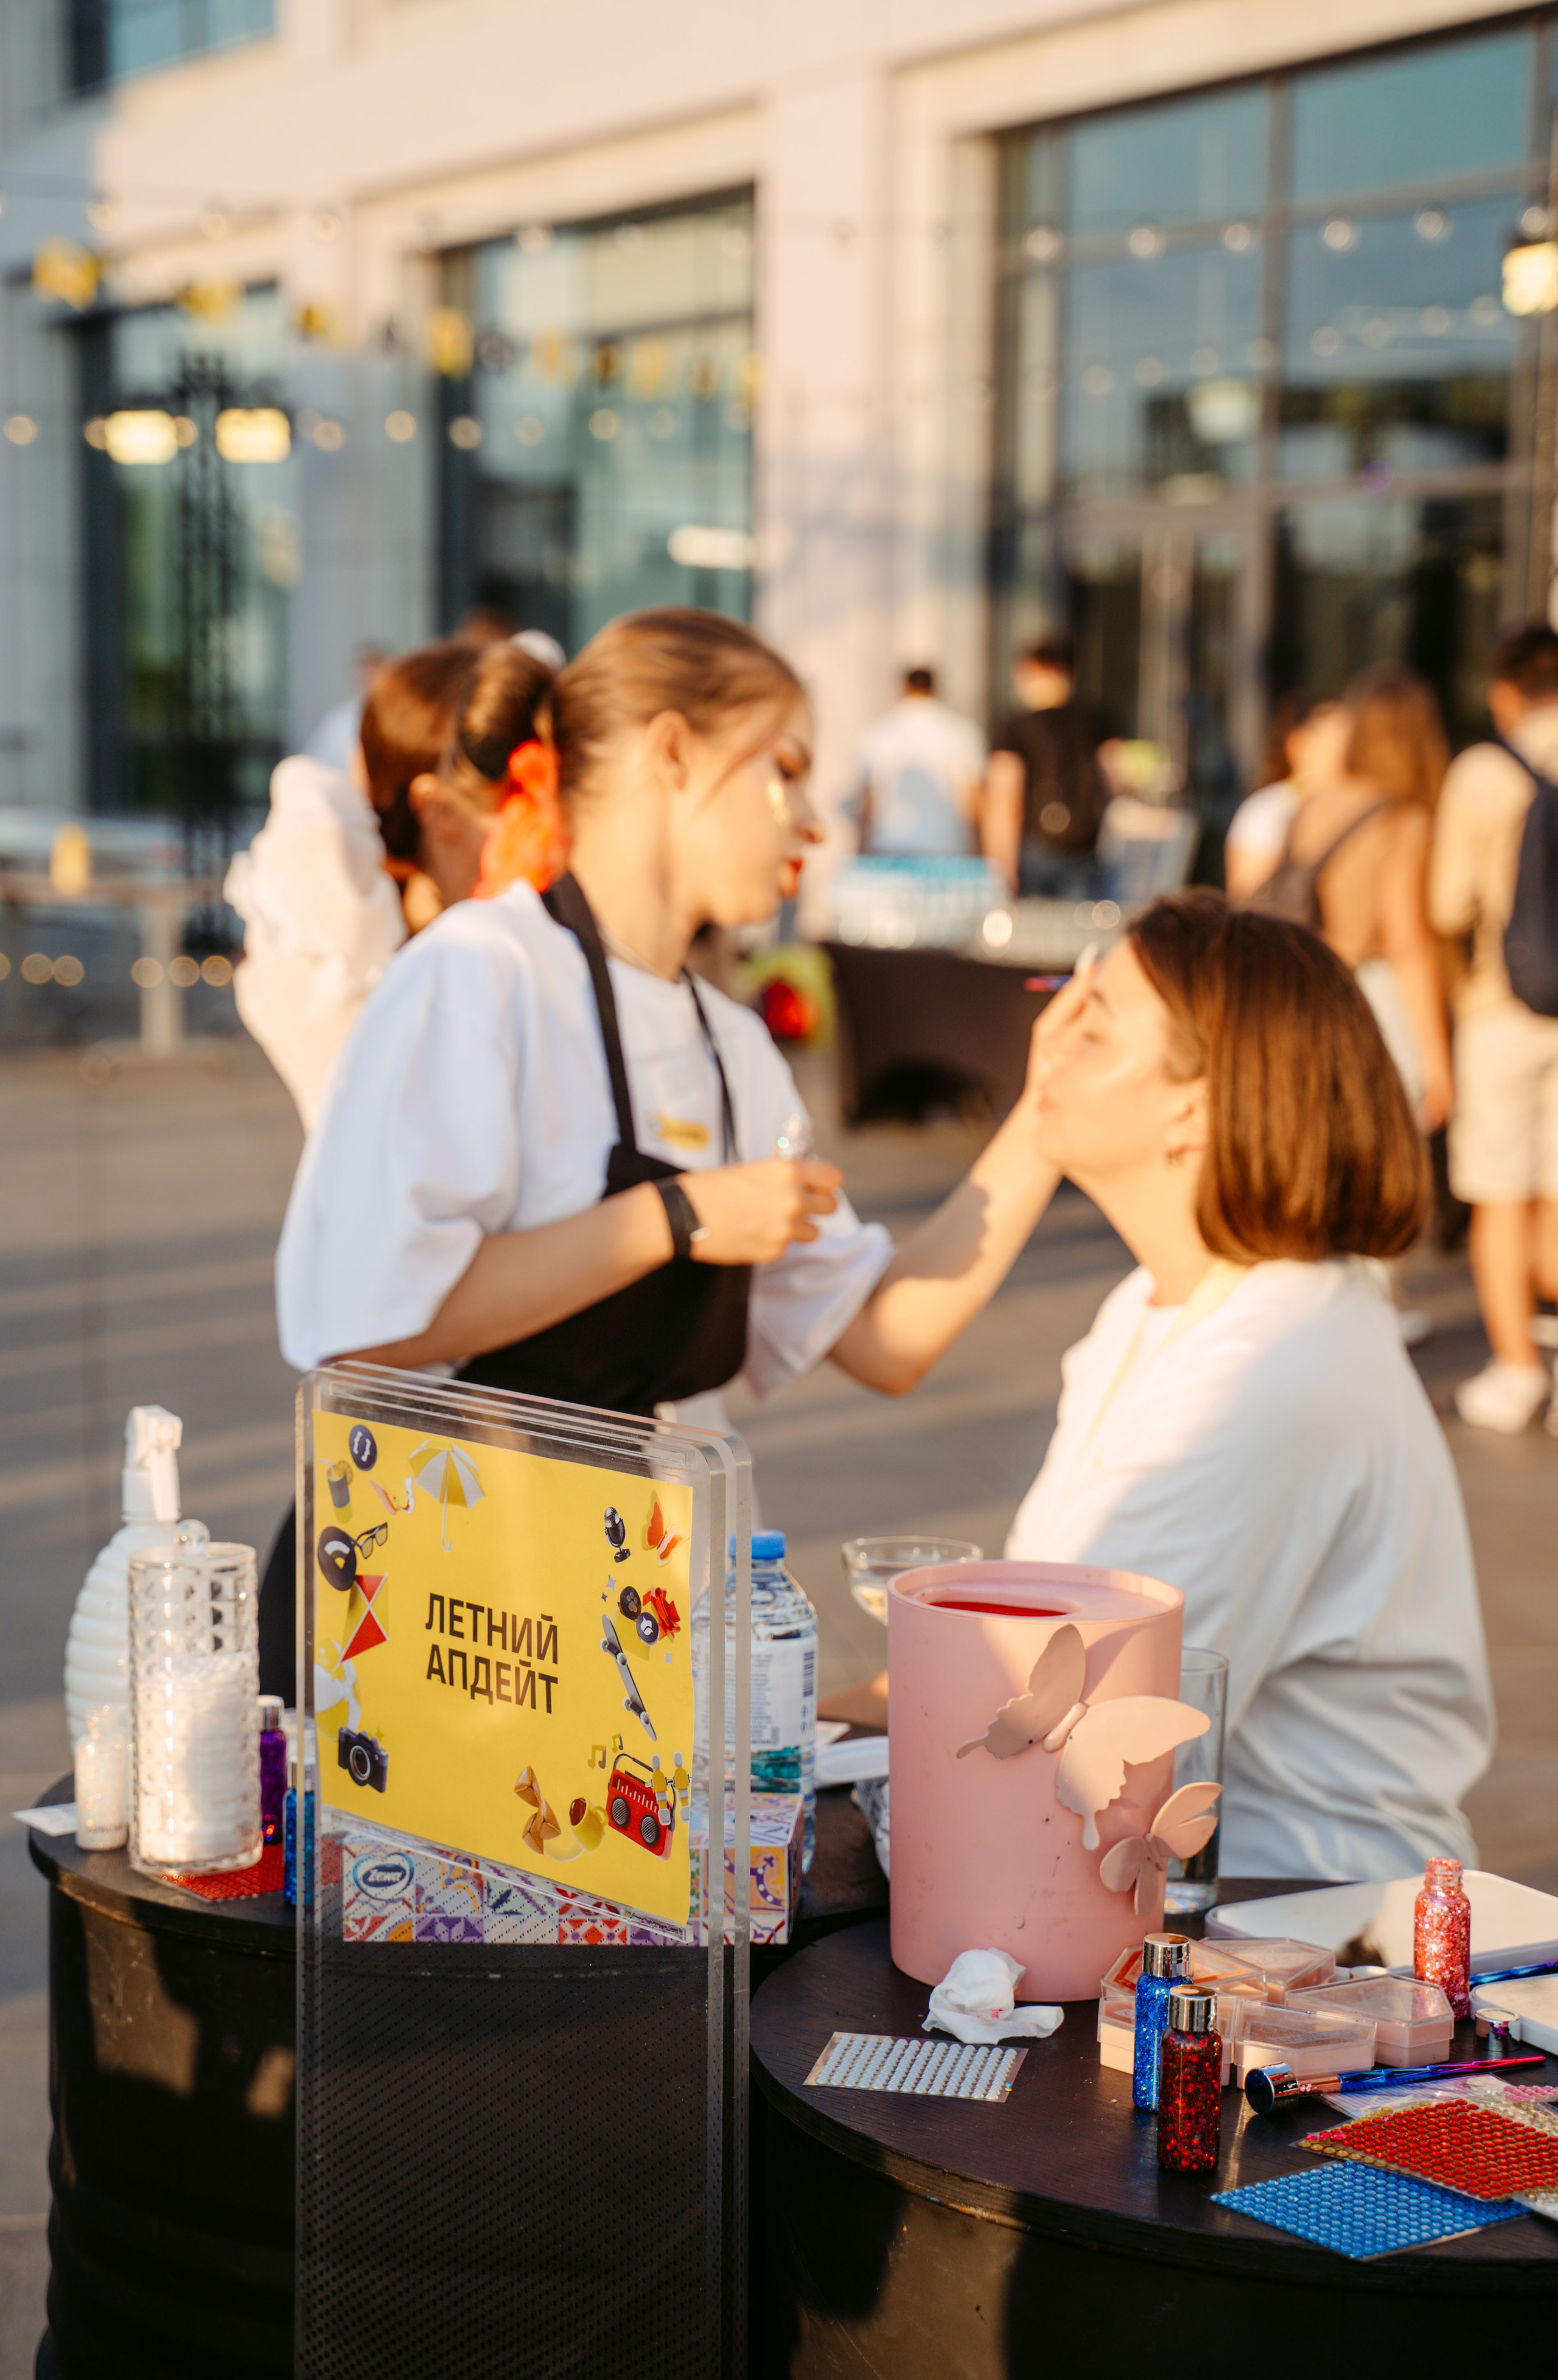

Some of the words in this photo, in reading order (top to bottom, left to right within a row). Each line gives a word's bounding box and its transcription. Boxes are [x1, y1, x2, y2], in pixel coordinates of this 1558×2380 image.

[425, 1593, 558, 1664] ЛЕТНИЙ
[427, 1644, 558, 1714] АПДЕЙТ
[367, 1869, 402, 1882] Zewa
